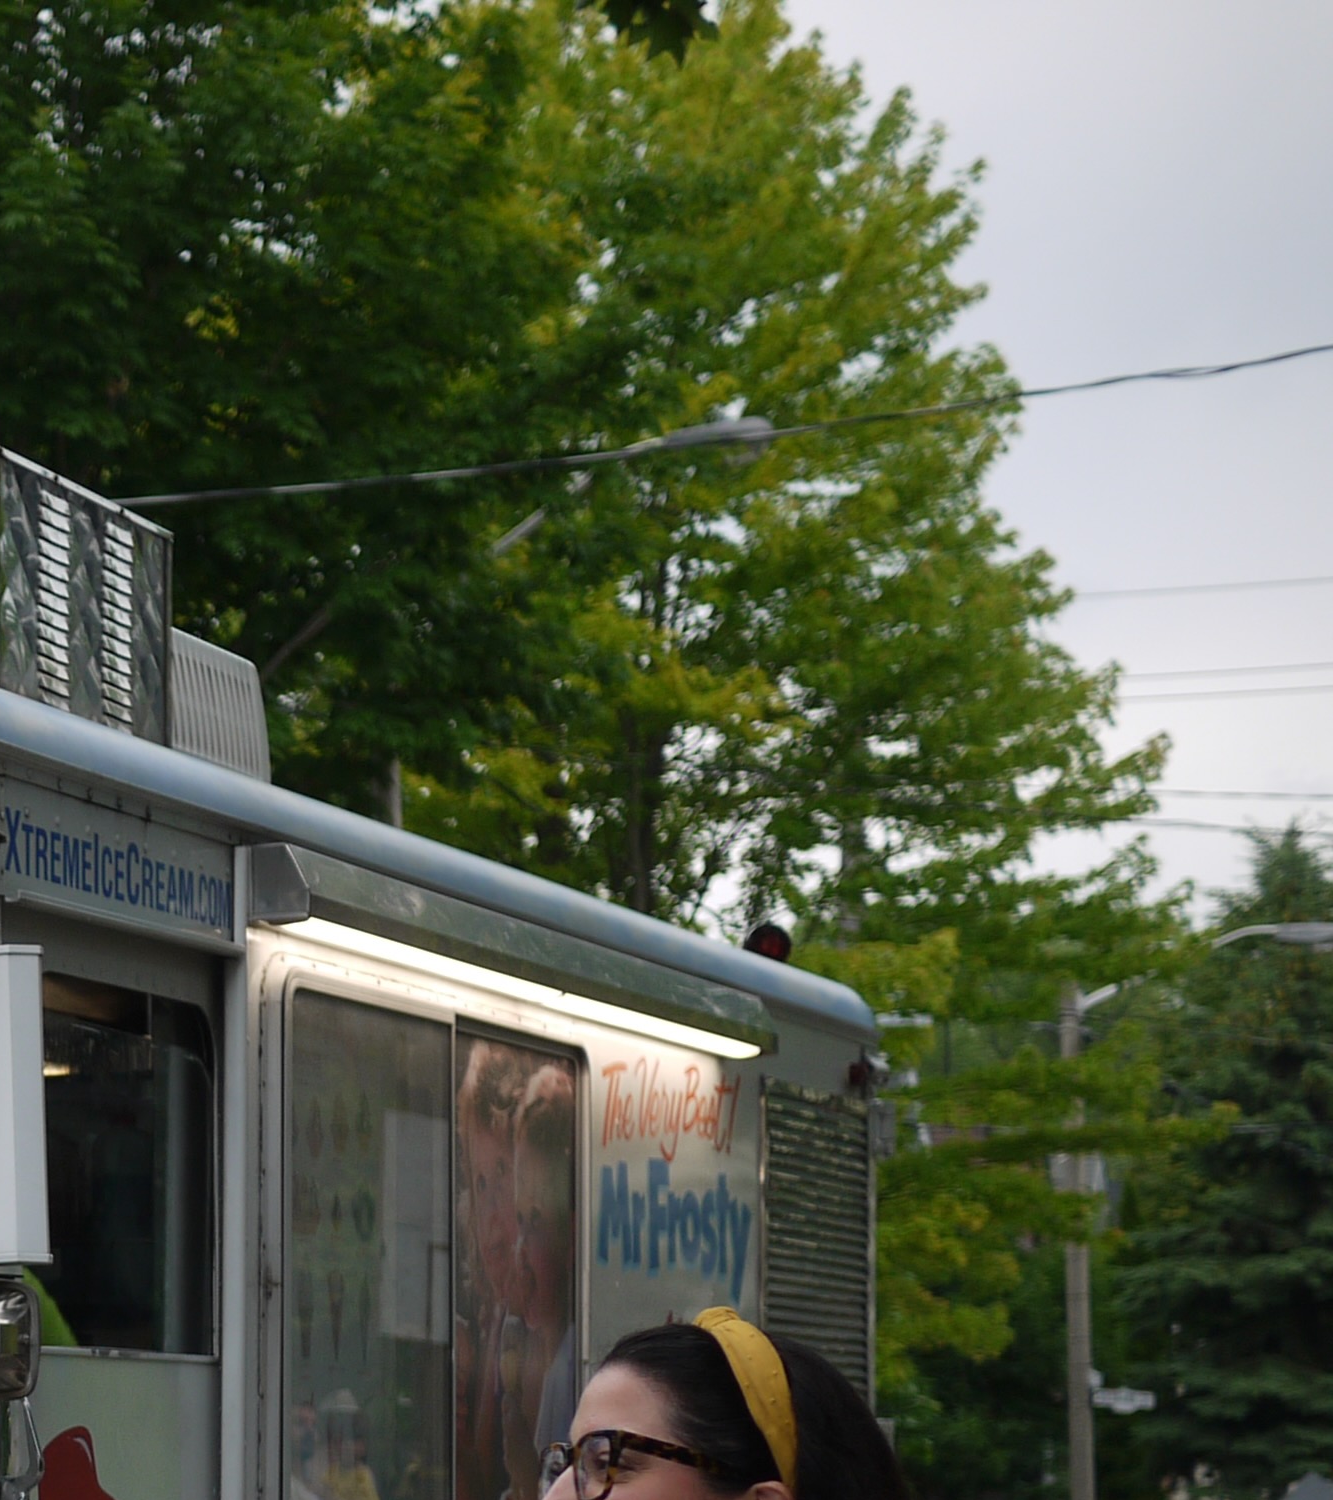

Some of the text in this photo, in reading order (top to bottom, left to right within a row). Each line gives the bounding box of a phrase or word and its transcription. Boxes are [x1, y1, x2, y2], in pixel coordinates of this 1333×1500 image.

[601, 1061, 636, 1148] The
[634, 1056, 684, 1163] Very
[597, 1156, 752, 1308] Mr Frosty
